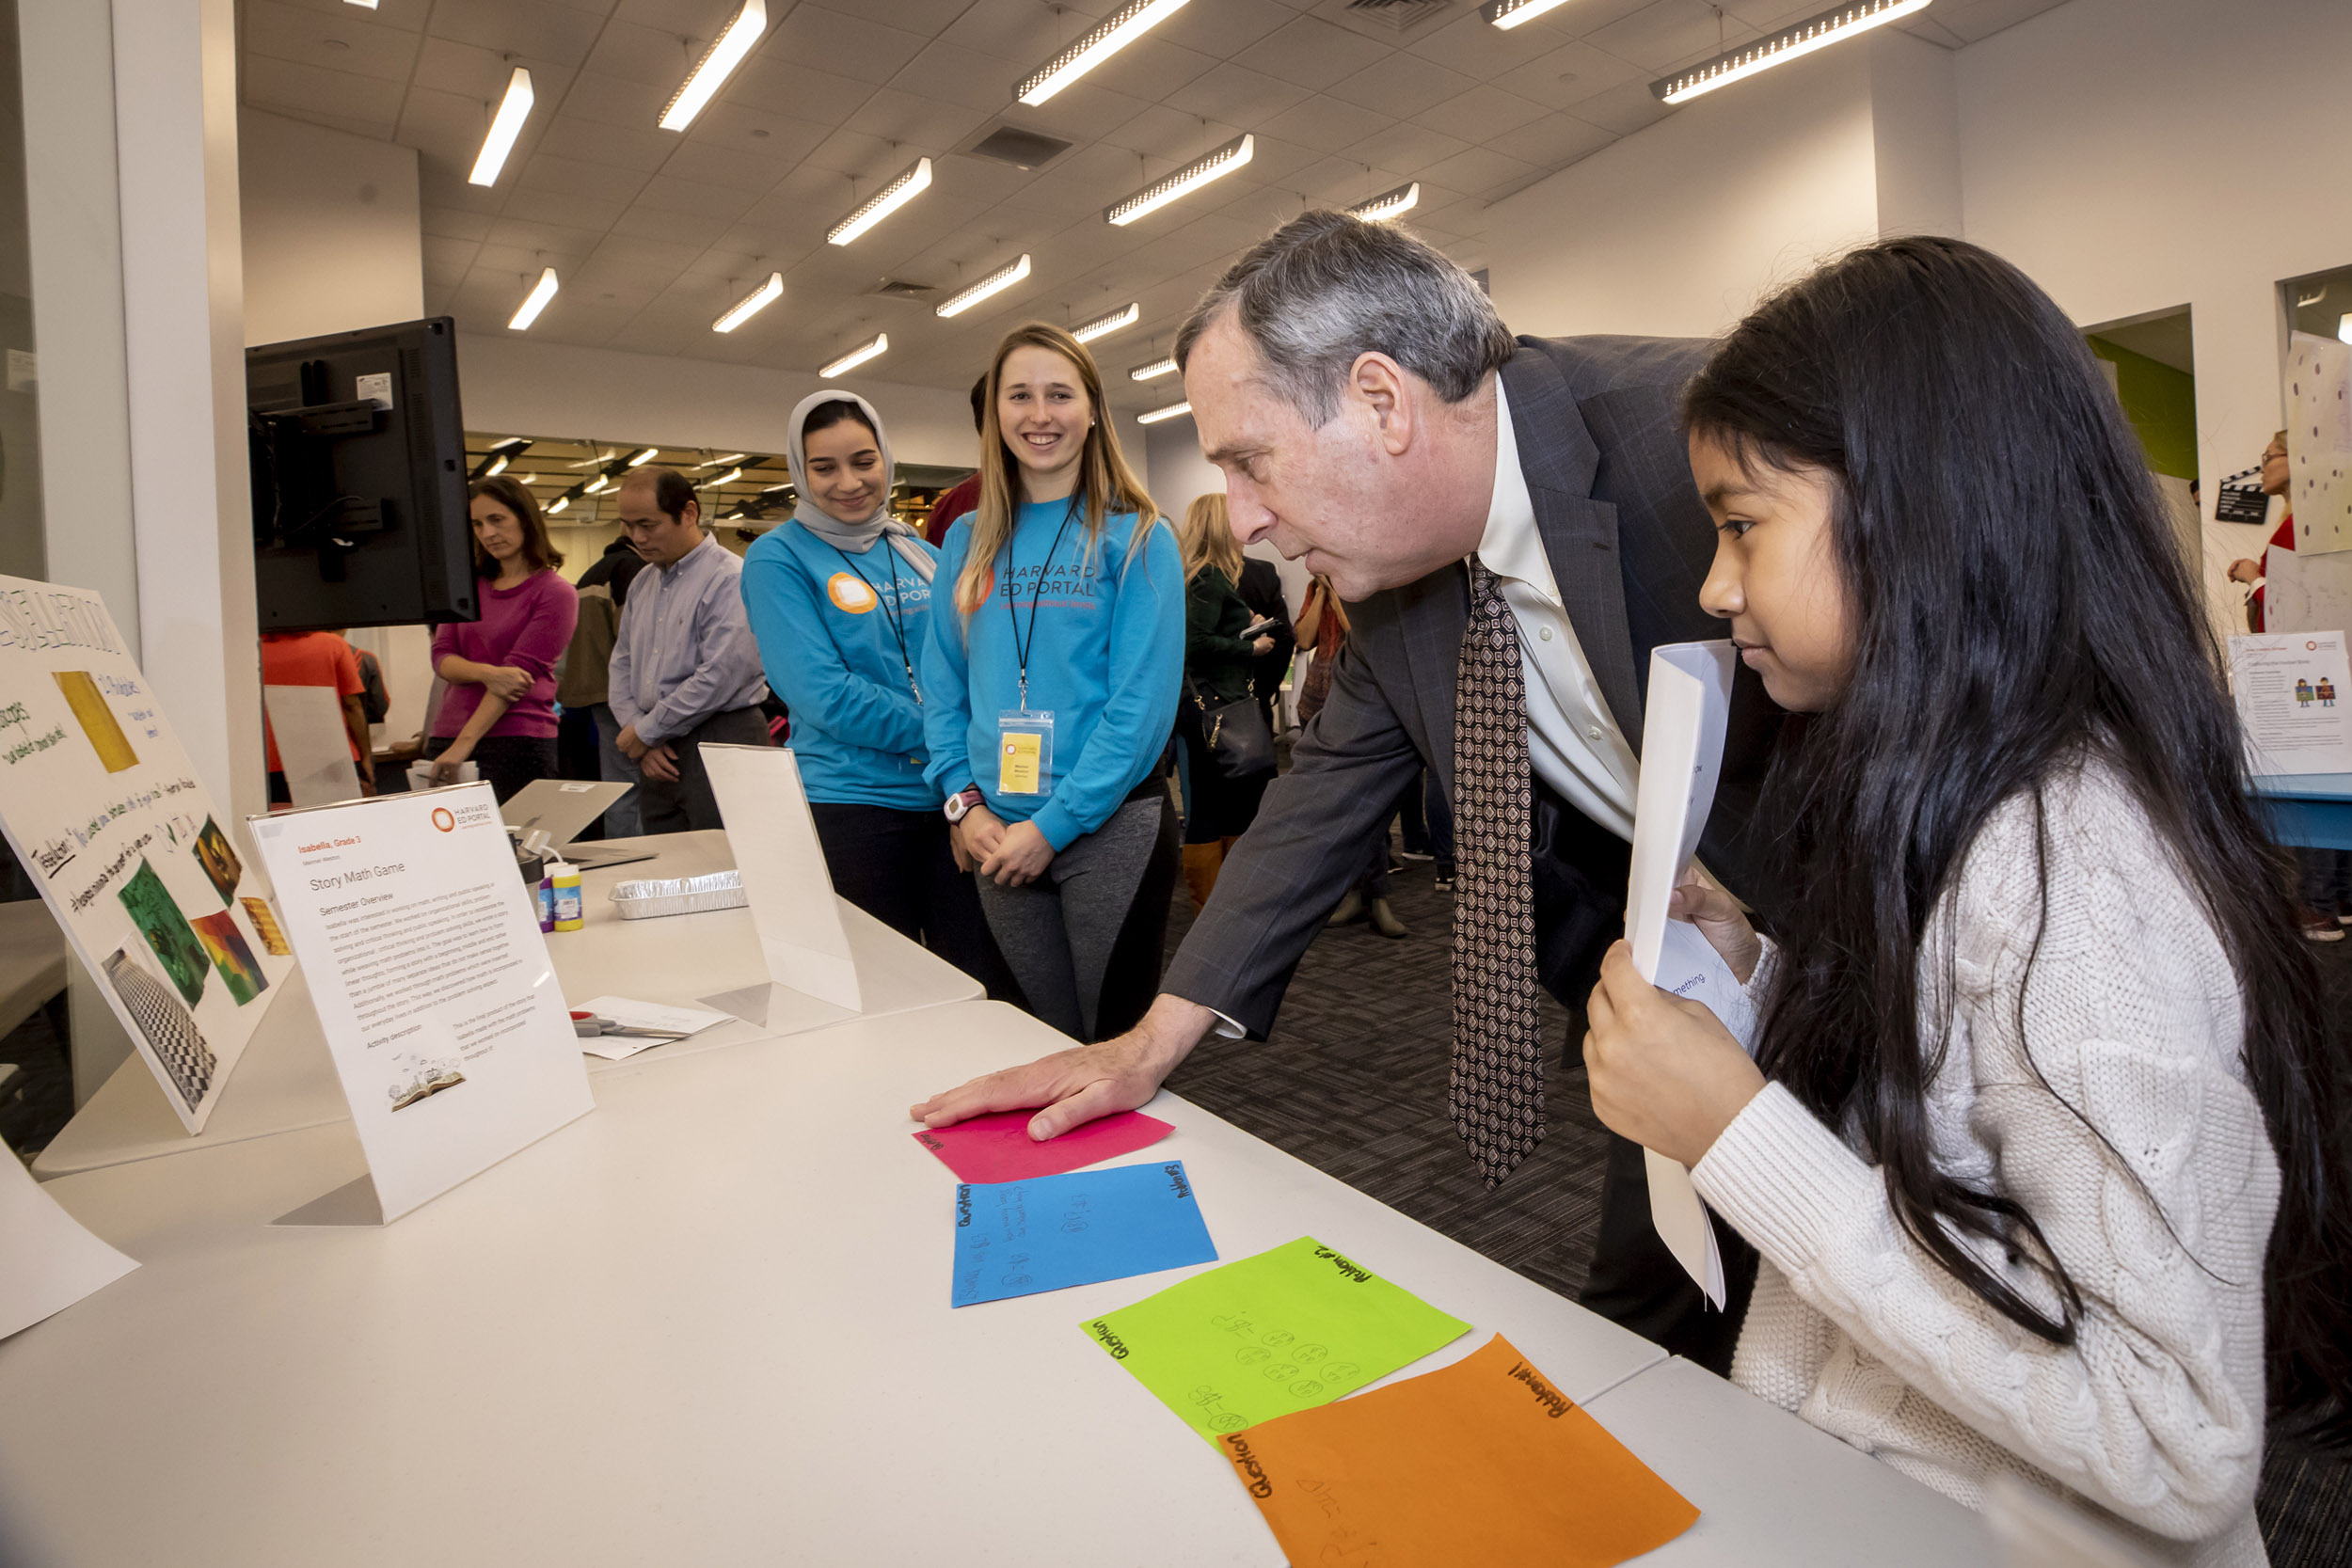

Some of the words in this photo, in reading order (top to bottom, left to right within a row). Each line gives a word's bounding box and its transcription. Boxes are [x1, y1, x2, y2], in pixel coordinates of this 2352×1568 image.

[1003, 564, 1096, 579] HARVARD
[872, 578, 928, 593] HARVA
[1000, 583, 1022, 597] ED
[1027, 580, 1096, 597] PORTAL
[899, 589, 930, 604] POR
[454, 804, 488, 815] HARVARD
[468, 813, 490, 821] PORTAL
[298, 842, 333, 853] Isabella,
[333, 837, 356, 847] Grade
[310, 877, 342, 892] Story
[343, 868, 373, 883] Math
[373, 863, 405, 877] Game
[320, 901, 358, 916] Semester
[360, 894, 393, 906] Overview
[1673, 974, 1706, 995] mething.
[367, 1037, 389, 1049] Activity
[389, 1024, 421, 1040] description
[958, 1184, 972, 1227] Question
[1092, 1321, 1130, 1360] Question
[1227, 1433, 1274, 1499] Question
